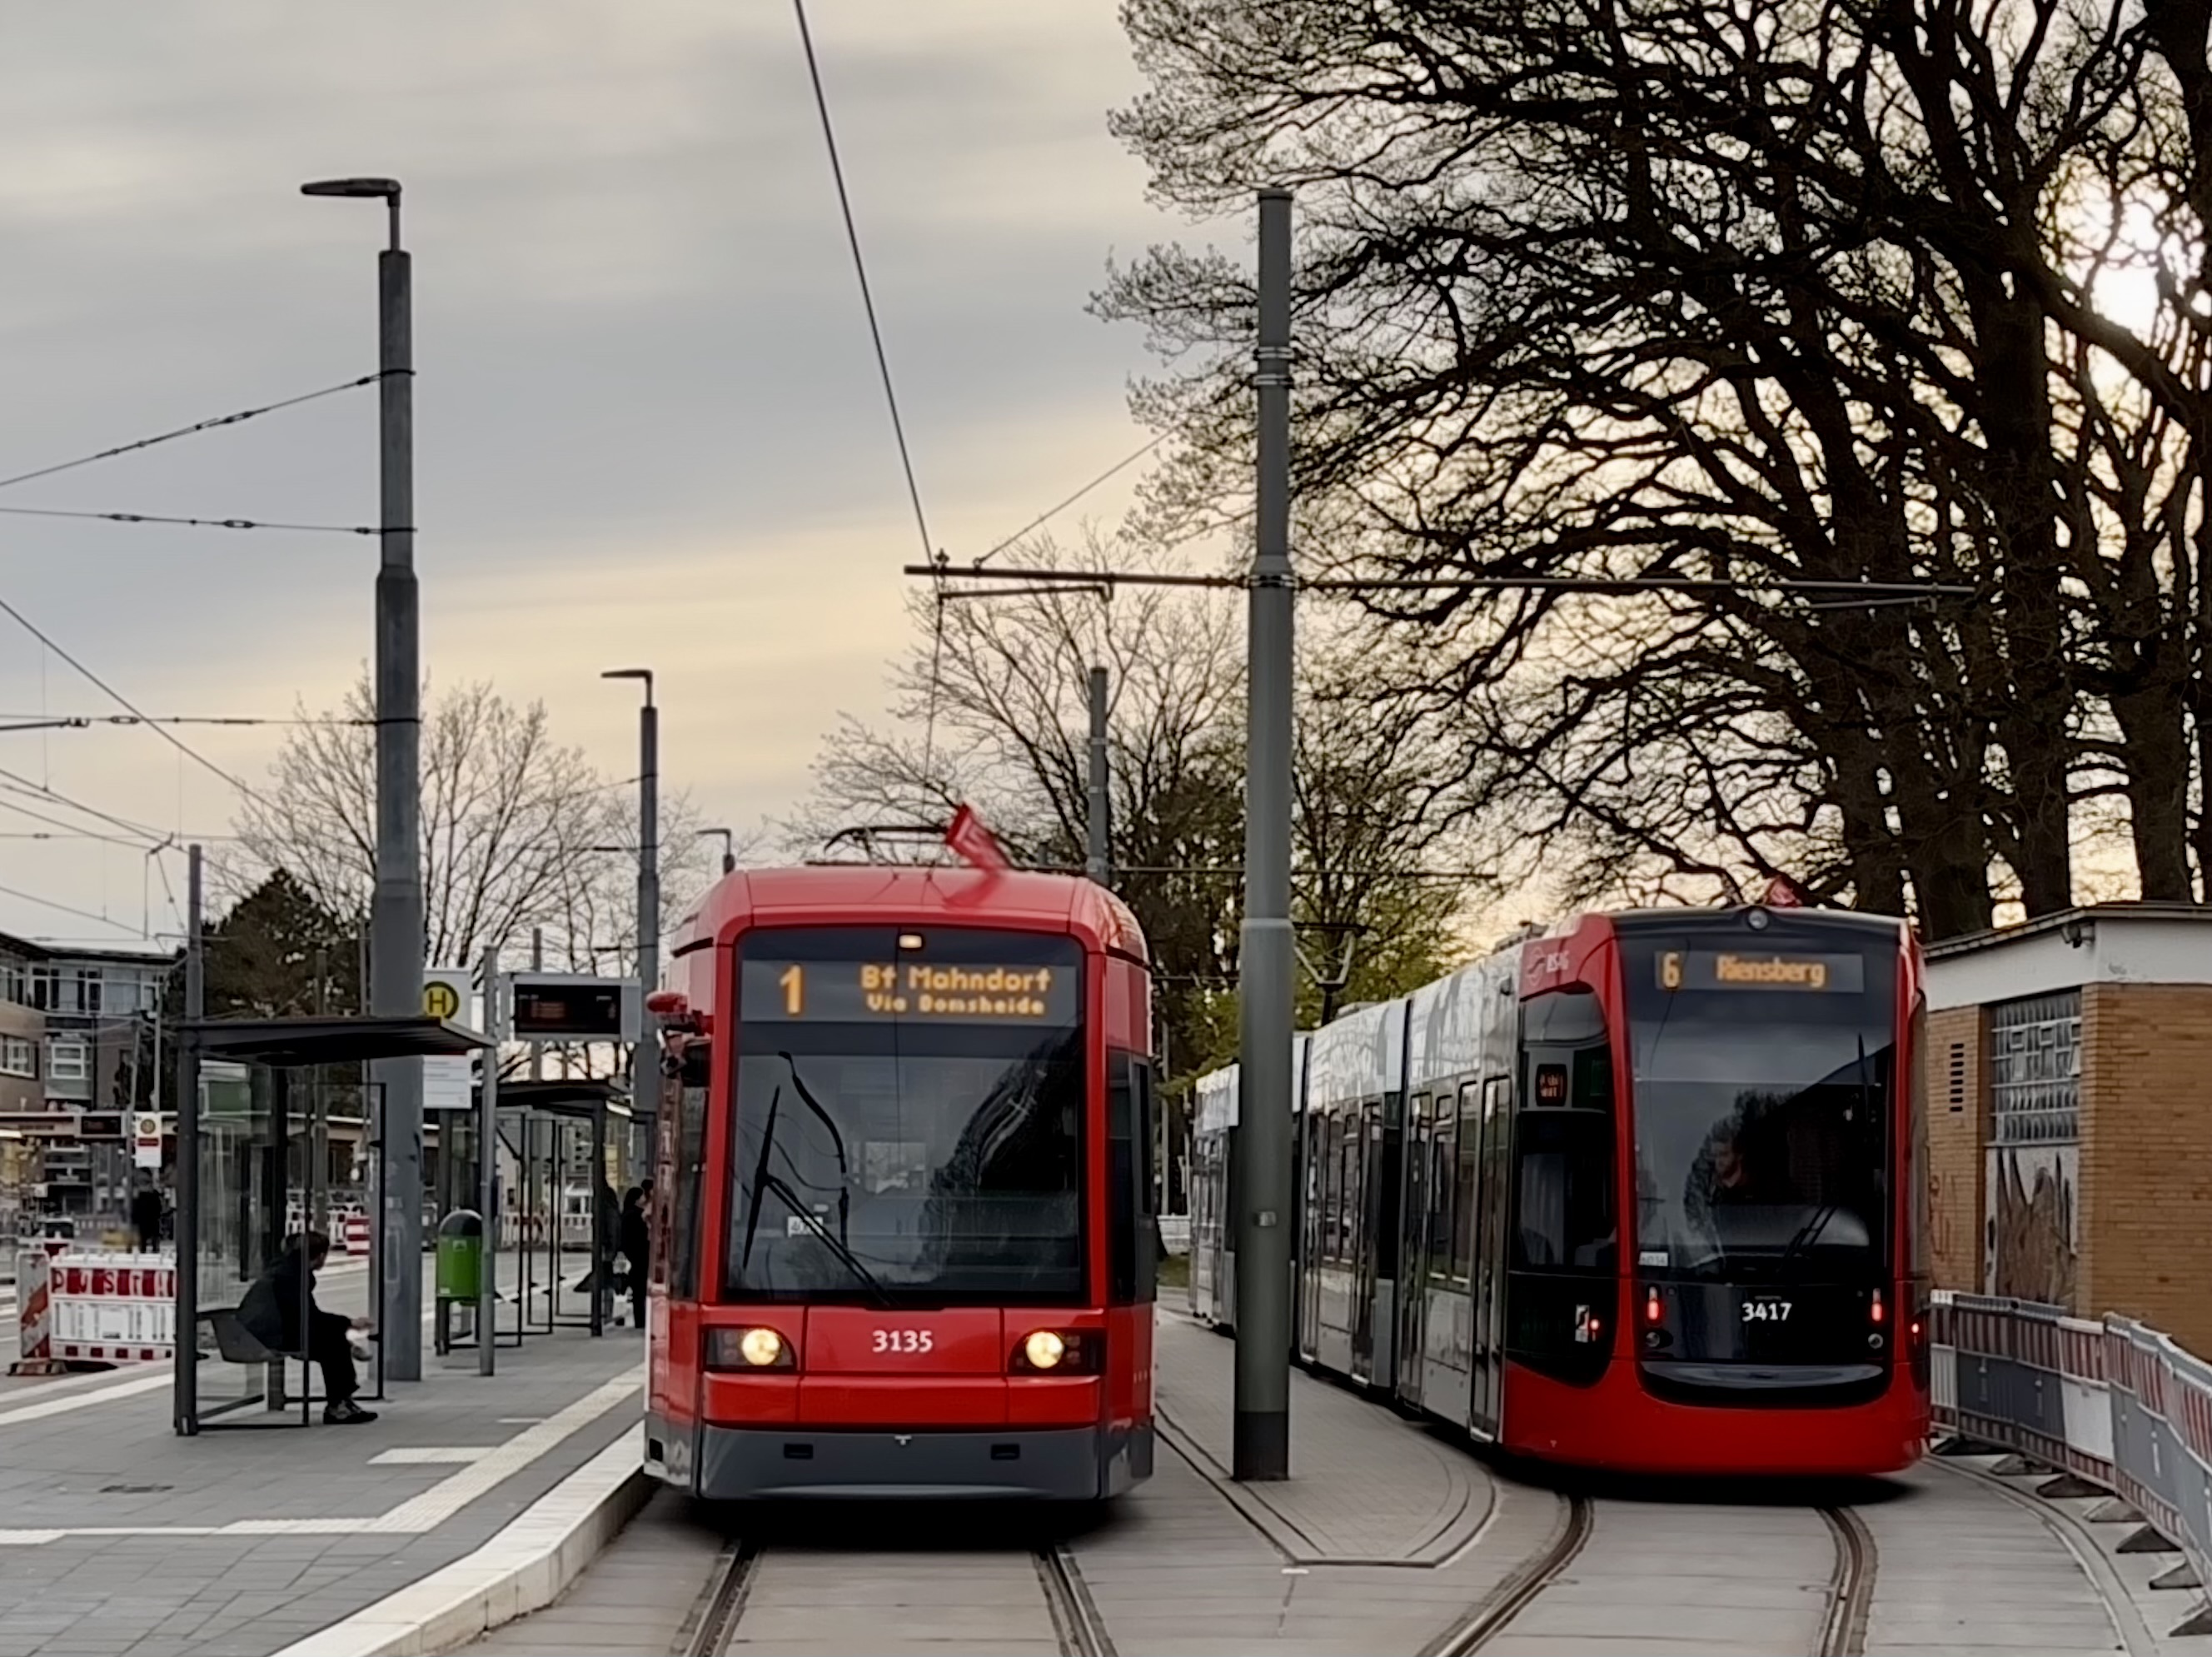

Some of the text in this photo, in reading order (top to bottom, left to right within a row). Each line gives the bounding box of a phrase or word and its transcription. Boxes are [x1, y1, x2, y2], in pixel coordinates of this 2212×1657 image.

[1662, 952, 1825, 988] 6 Riensberg
[780, 964, 1051, 1015] 1 Bf Mahndorf
[428, 991, 446, 1014] H
[866, 993, 1044, 1015] Via Domsheide
[1741, 1302, 1793, 1323] 3417
[872, 1330, 934, 1353] 3135
